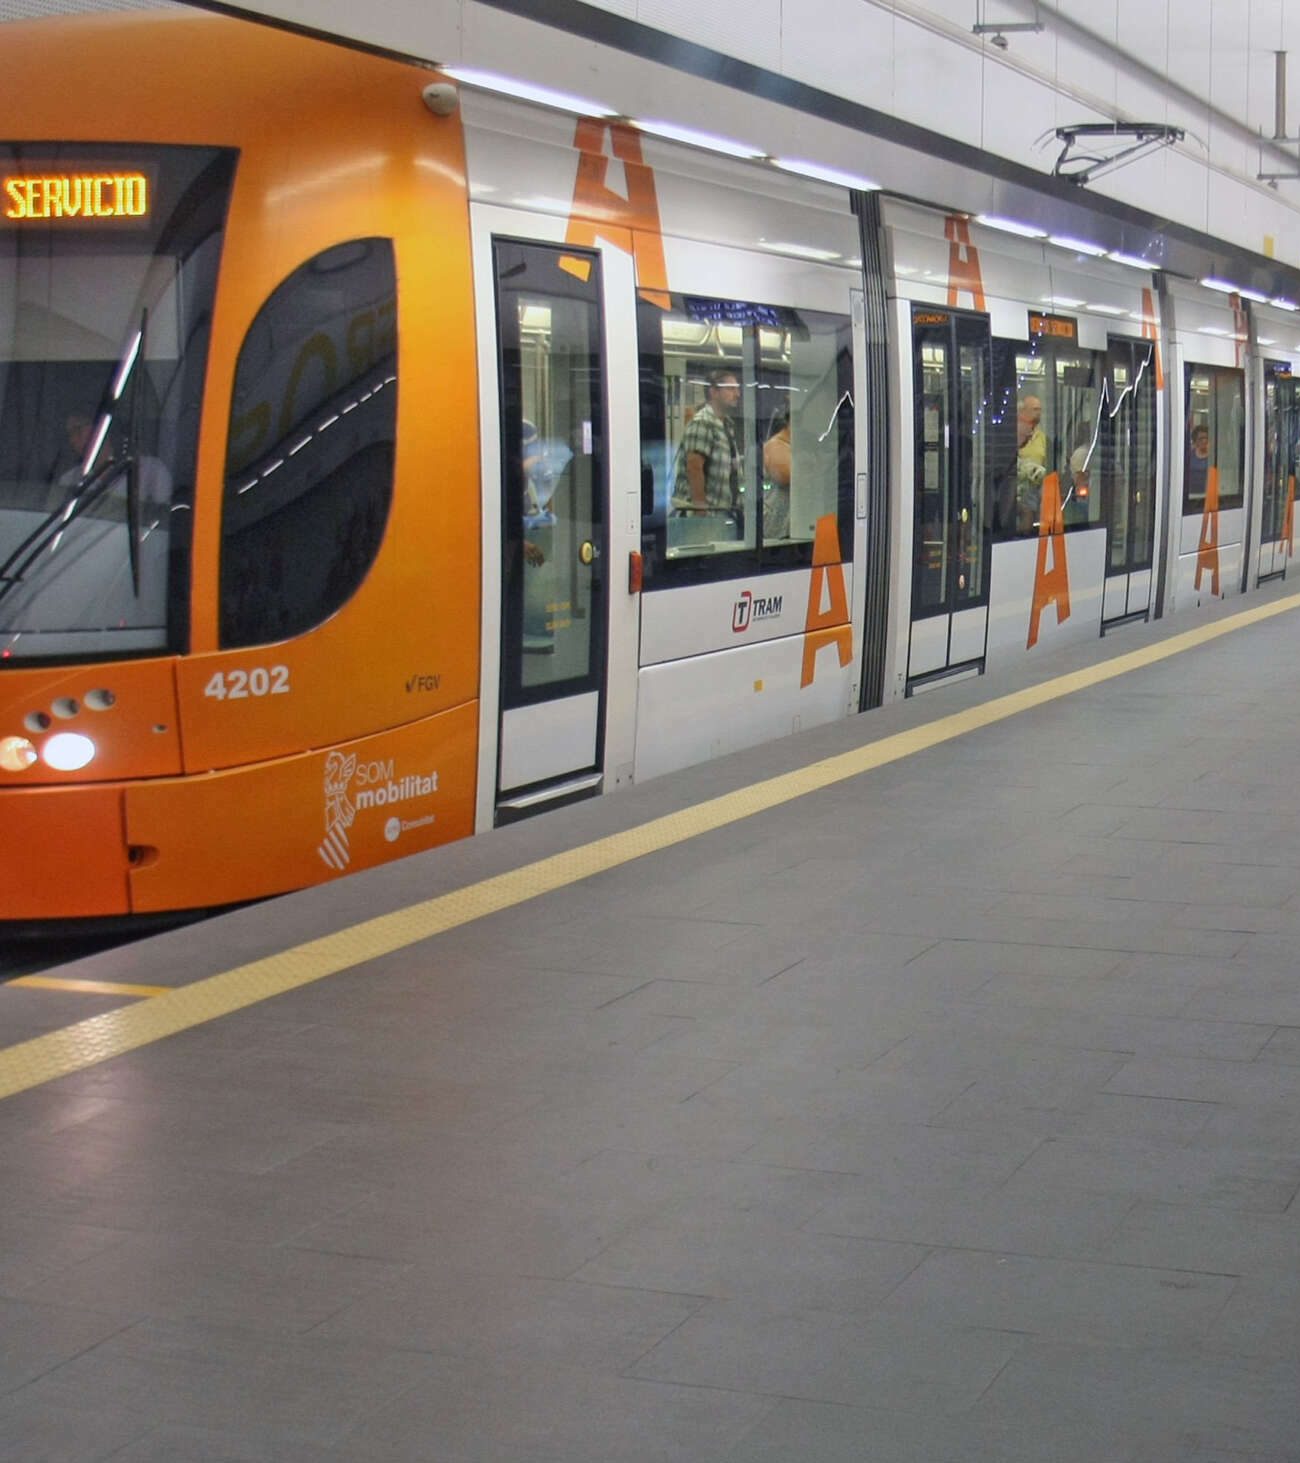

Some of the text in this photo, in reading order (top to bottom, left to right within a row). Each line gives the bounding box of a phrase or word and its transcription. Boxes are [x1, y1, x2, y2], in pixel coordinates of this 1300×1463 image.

[6, 173, 148, 220] SERVICIO
[753, 595, 782, 617] TRAM
[204, 665, 290, 700] 4202
[417, 674, 440, 692] FGV
[355, 759, 394, 786] SOM
[355, 771, 439, 810] mobilitat
